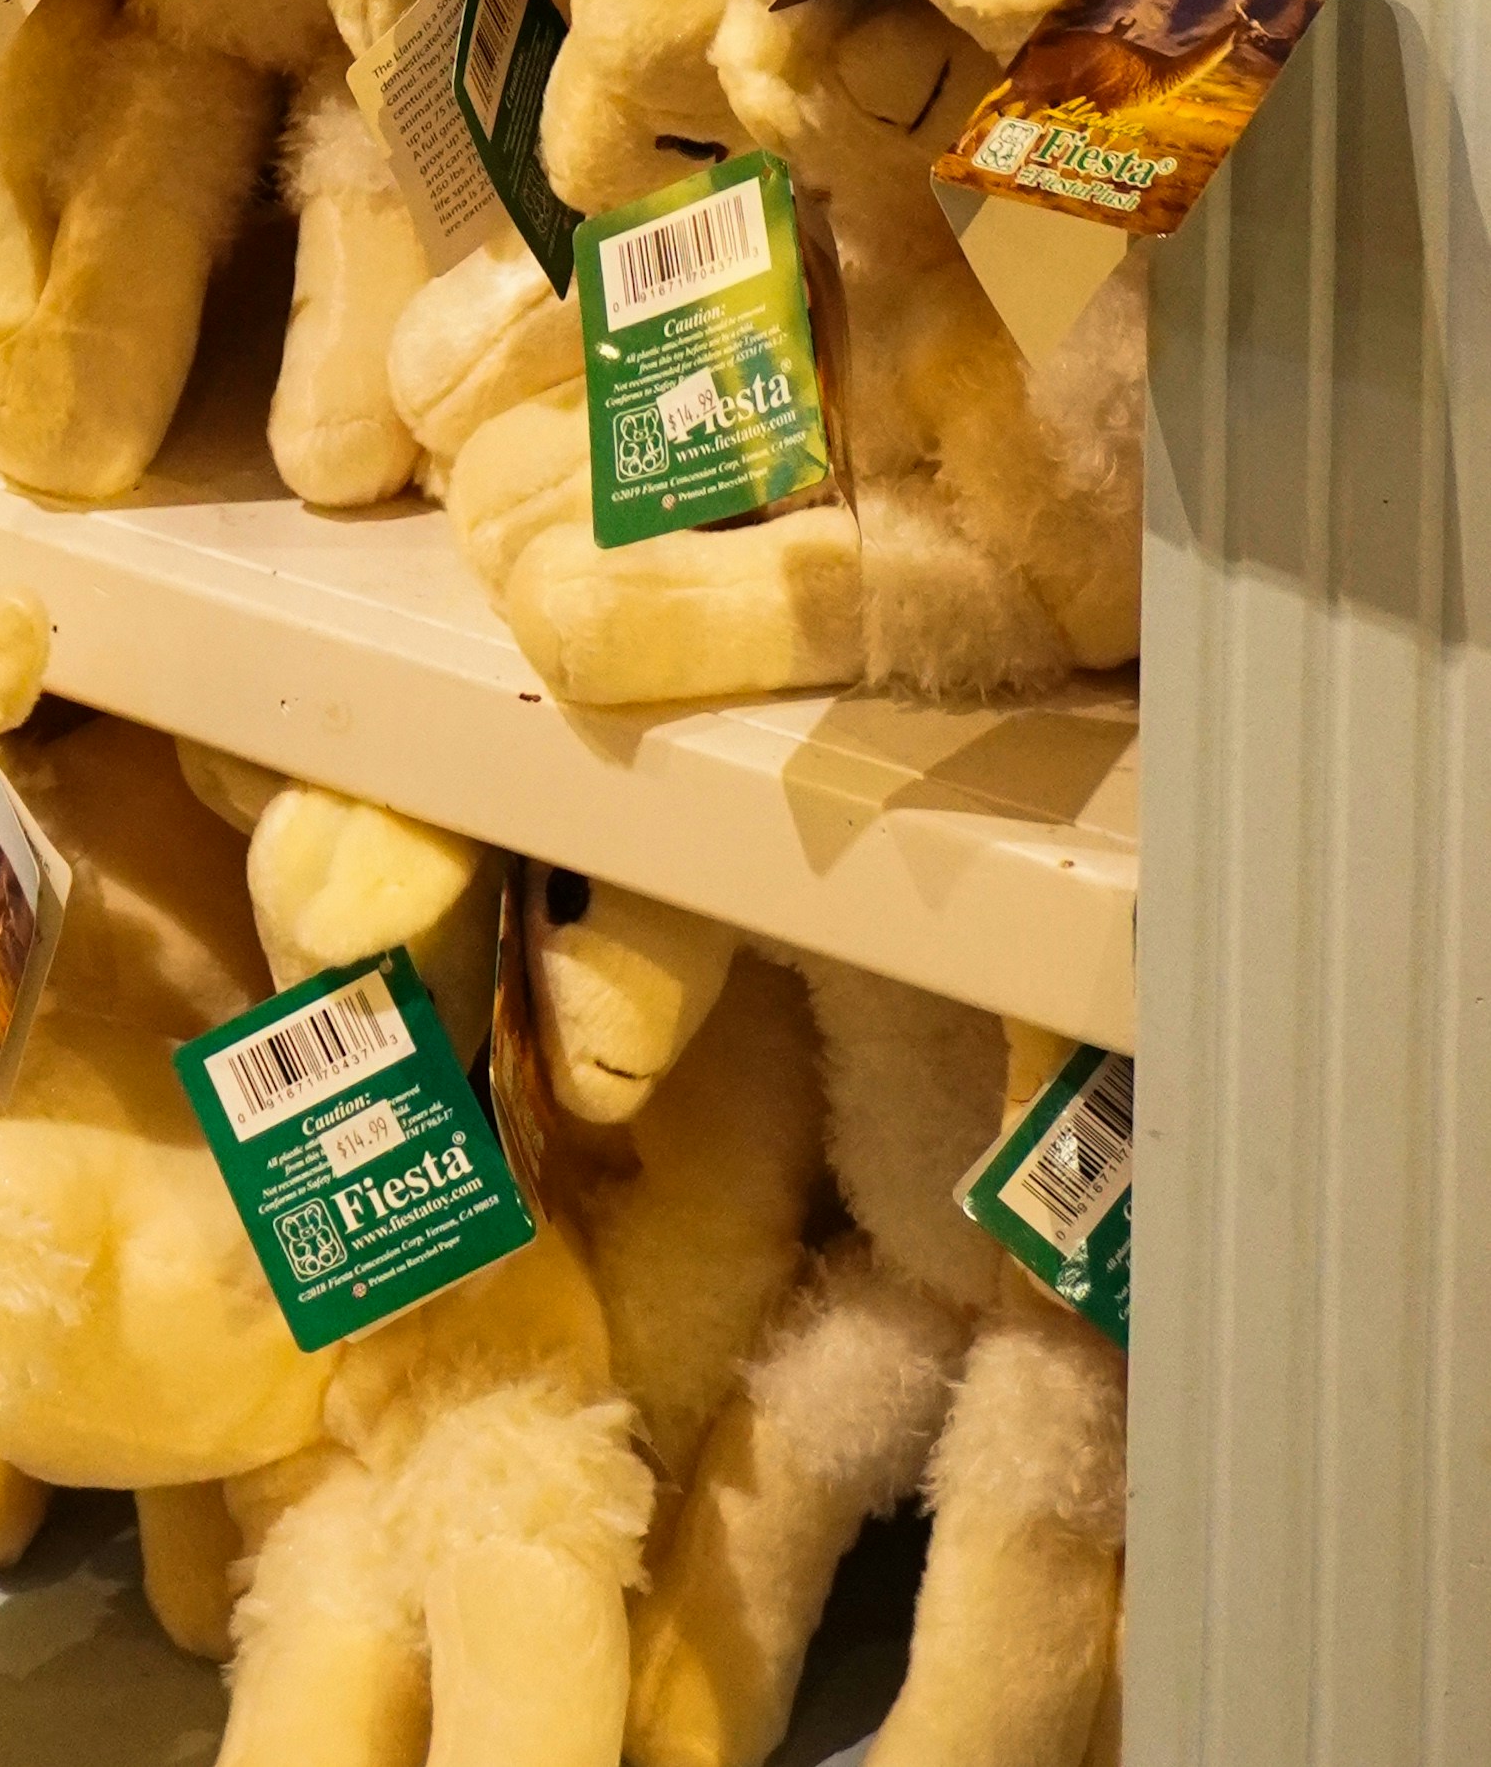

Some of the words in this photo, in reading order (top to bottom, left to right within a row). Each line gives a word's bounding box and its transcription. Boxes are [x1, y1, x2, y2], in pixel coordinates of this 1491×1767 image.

[373, 55, 393, 80] The
[392, 28, 424, 62] Llama
[377, 25, 446, 94] domesticated
[415, 49, 441, 80] They
[391, 73, 438, 120] centuries
[420, 129, 438, 151] full
[428, 177, 450, 201] 450
[611, 301, 621, 313] 0
[637, 276, 686, 304] 91671
[689, 254, 737, 283] 70437
[663, 305, 726, 338] Caution:
[669, 389, 715, 430] $14.99
[676, 411, 797, 464] www.fiestatoy.com
[236, 1113, 247, 1124] 0
[264, 1074, 317, 1110] 91671
[320, 1047, 372, 1080] 70437
[389, 1032, 401, 1046] 3
[302, 1091, 372, 1137] Caution:
[336, 1118, 392, 1160] $14.99
[1077, 1164, 1117, 1214] 91671
[349, 1177, 483, 1252] www.fiestatoy.com
[326, 1268, 355, 1289] Fiesta
[353, 1244, 402, 1275] Concession
[399, 1232, 426, 1253] Corp.
[458, 1207, 475, 1222] CA
